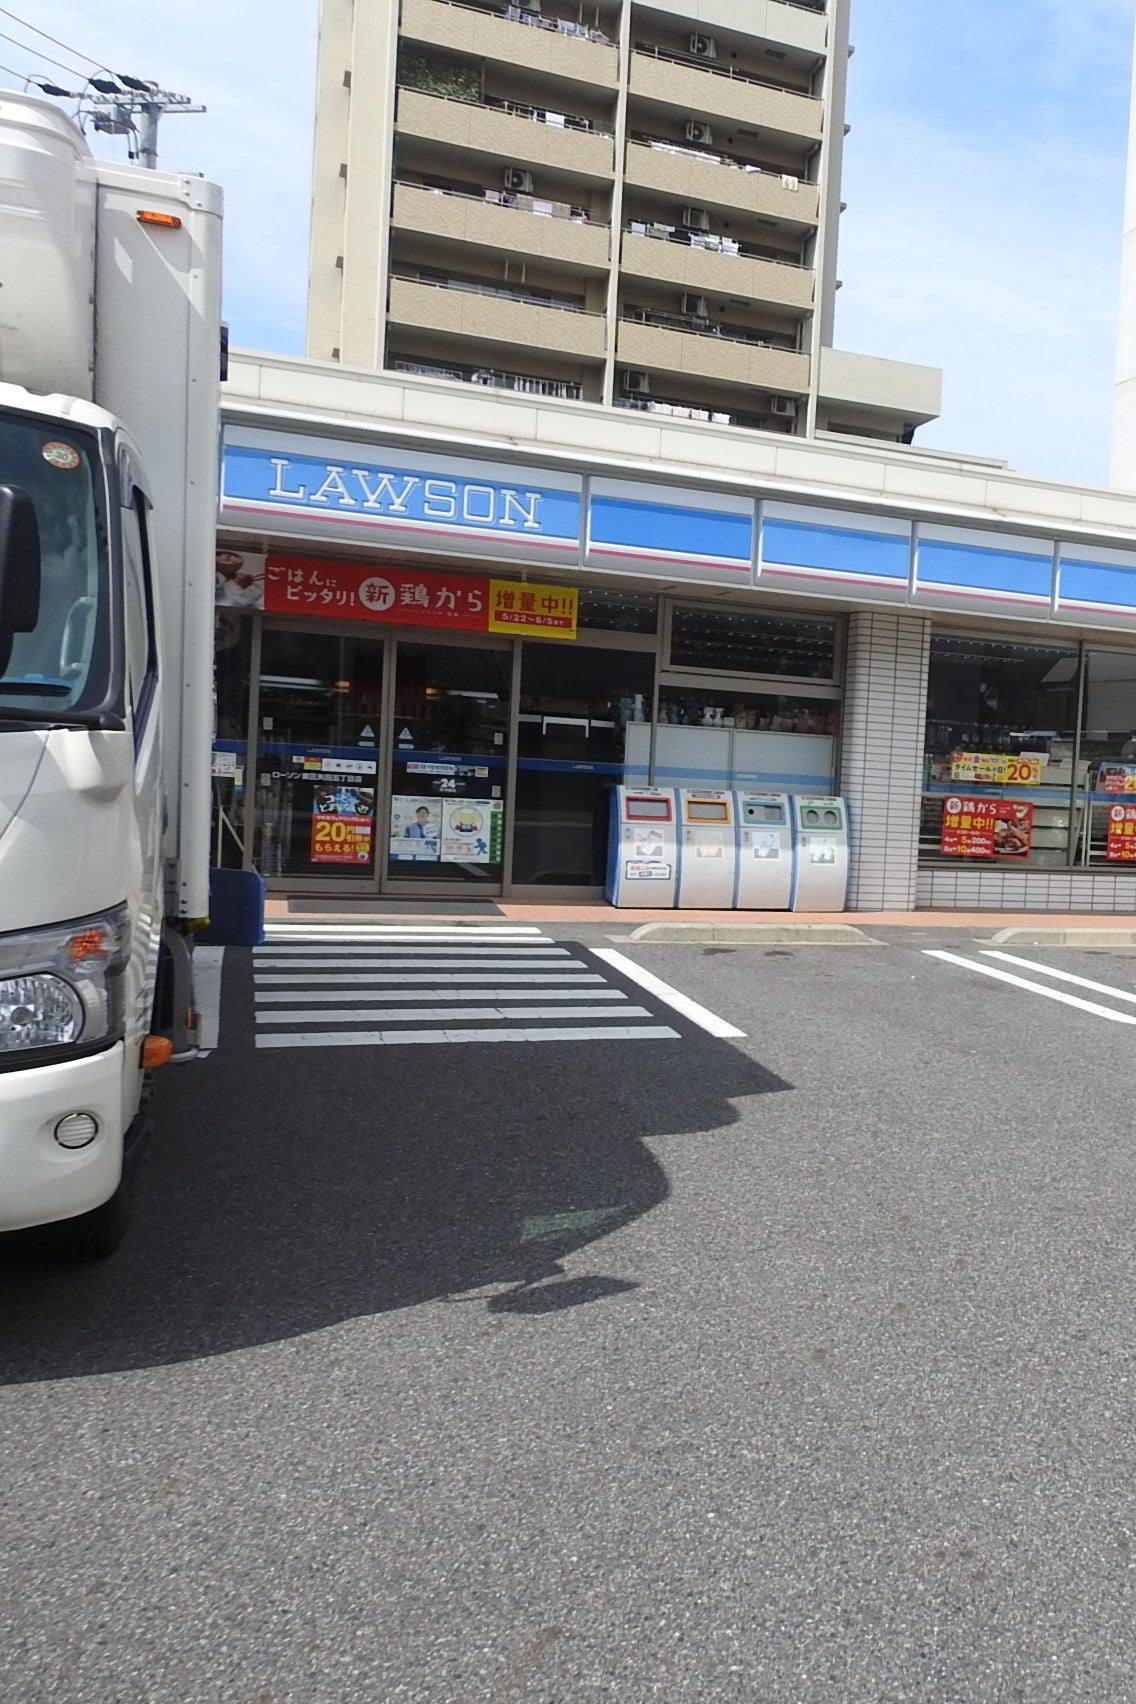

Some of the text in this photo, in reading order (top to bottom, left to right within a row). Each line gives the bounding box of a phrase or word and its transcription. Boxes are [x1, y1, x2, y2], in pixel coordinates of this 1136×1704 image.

[268, 458, 543, 530] LAWSON
[267, 566, 337, 588] ごはんに
[495, 590, 574, 615] 増量中!!
[440, 778, 456, 788] 24
[316, 821, 347, 842] 20
